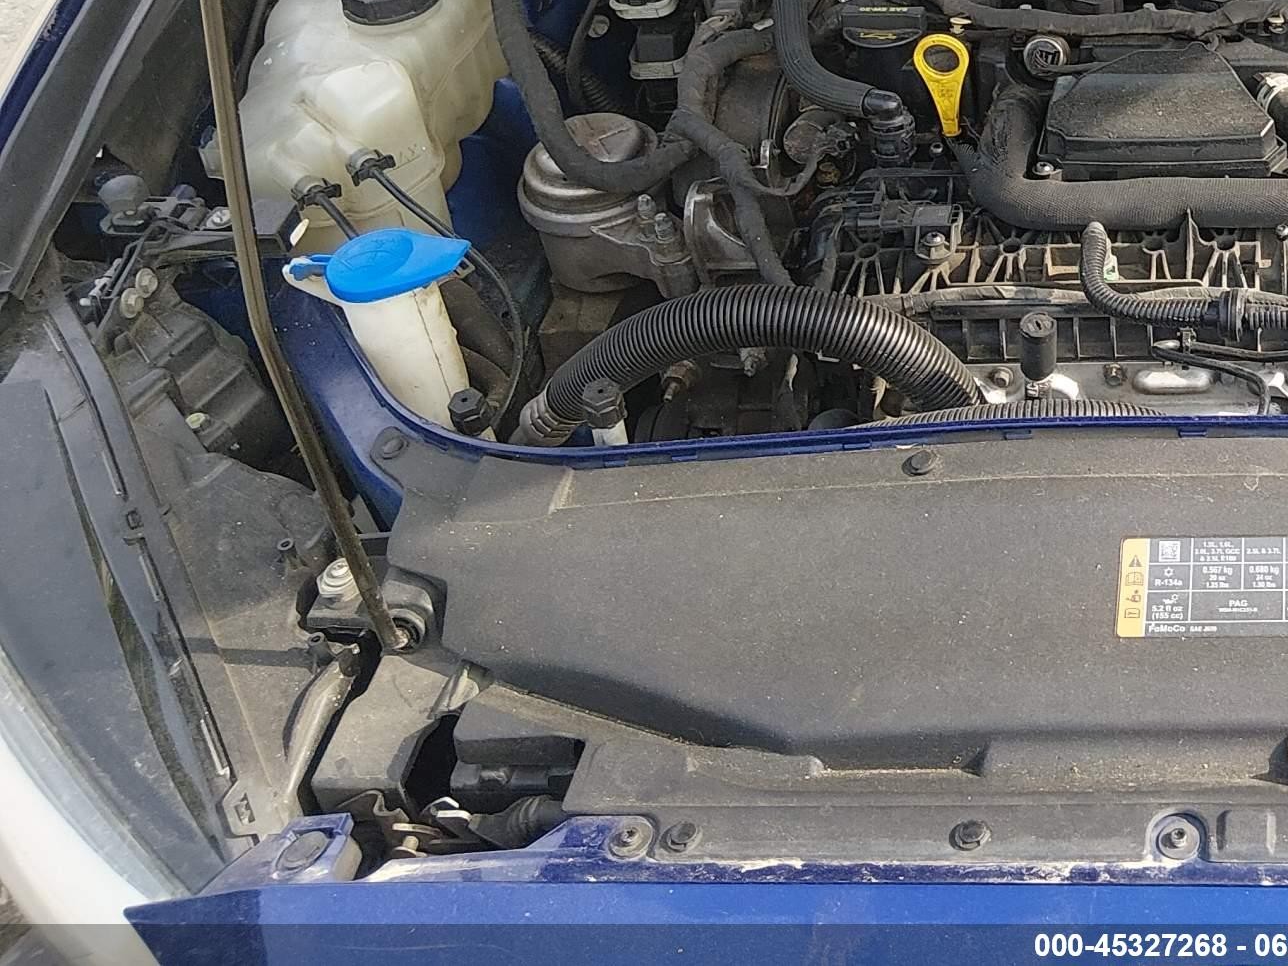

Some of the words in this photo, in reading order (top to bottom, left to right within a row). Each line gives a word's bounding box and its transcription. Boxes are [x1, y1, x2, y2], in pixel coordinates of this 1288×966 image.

[1223, 566, 1233, 576] kg
[1269, 566, 1280, 575] kg
[1154, 578, 1183, 586] R-134a
[1228, 599, 1248, 607] PAG
[1151, 604, 1165, 612] 5.2
[1151, 612, 1169, 620] (155
[1170, 612, 1184, 620] cc)
[1148, 623, 1186, 633] FoMoCo
